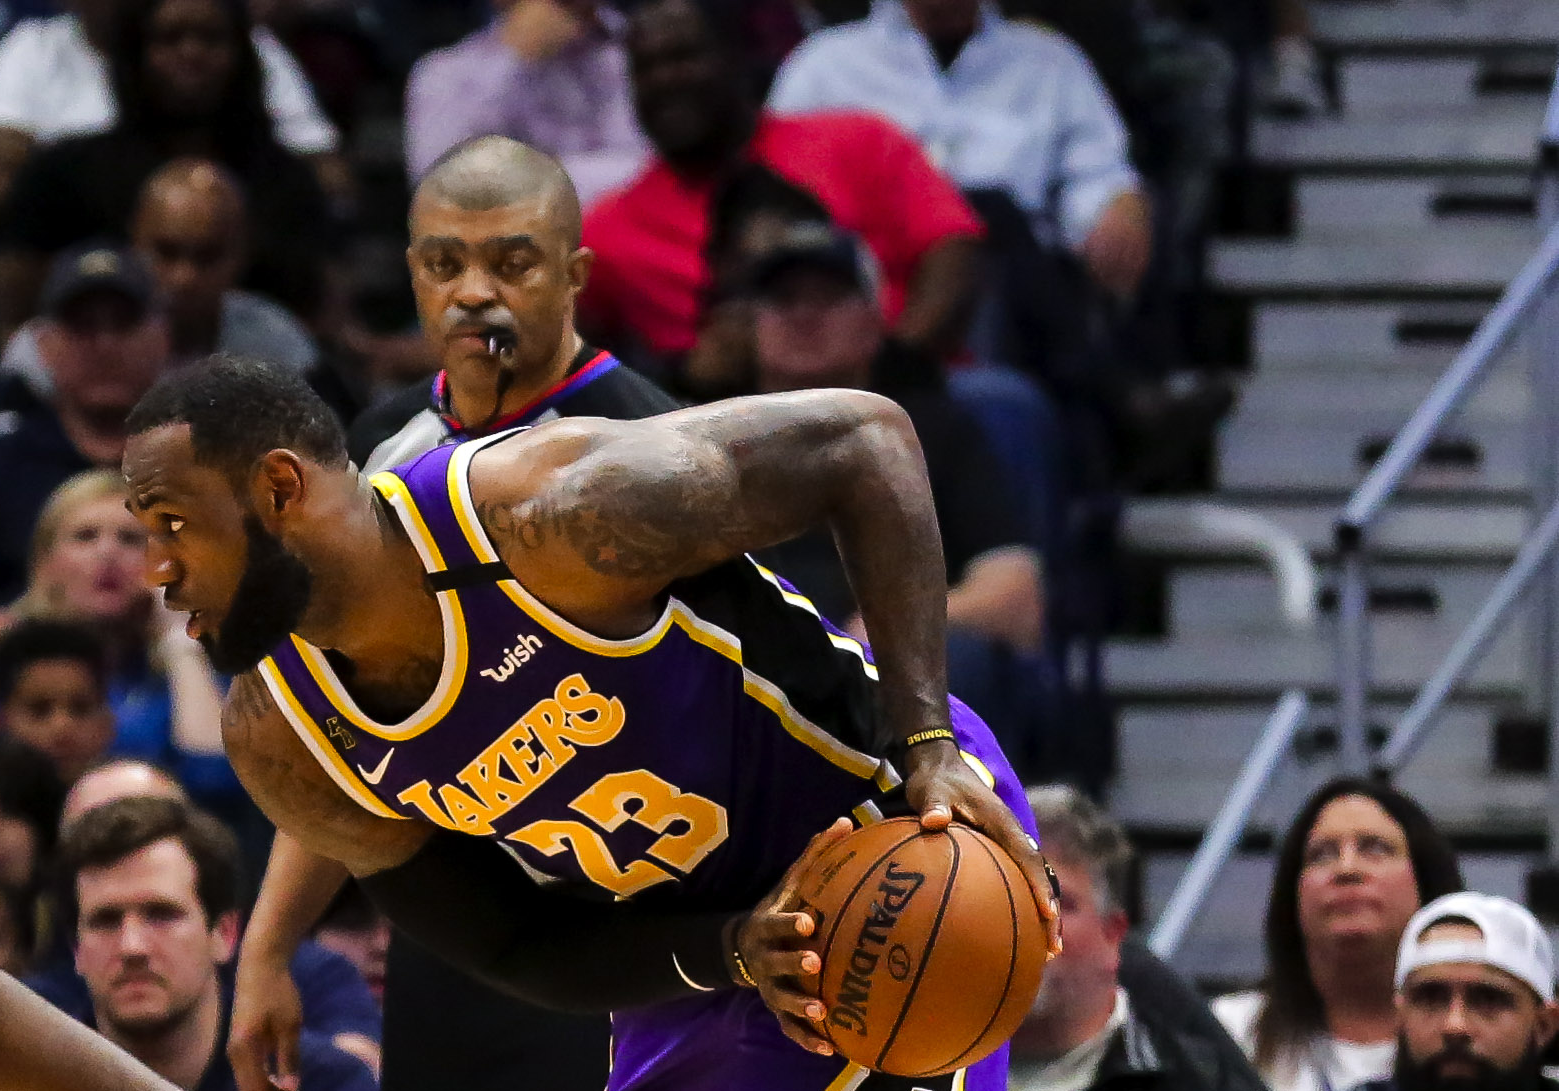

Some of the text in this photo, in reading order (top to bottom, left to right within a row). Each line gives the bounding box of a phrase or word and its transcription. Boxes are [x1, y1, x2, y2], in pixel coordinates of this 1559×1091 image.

[480, 634, 543, 682] wish
[397, 673, 626, 836] LAKERS
[504, 768, 730, 897] 23
[829, 861, 925, 1037] SPALDING
